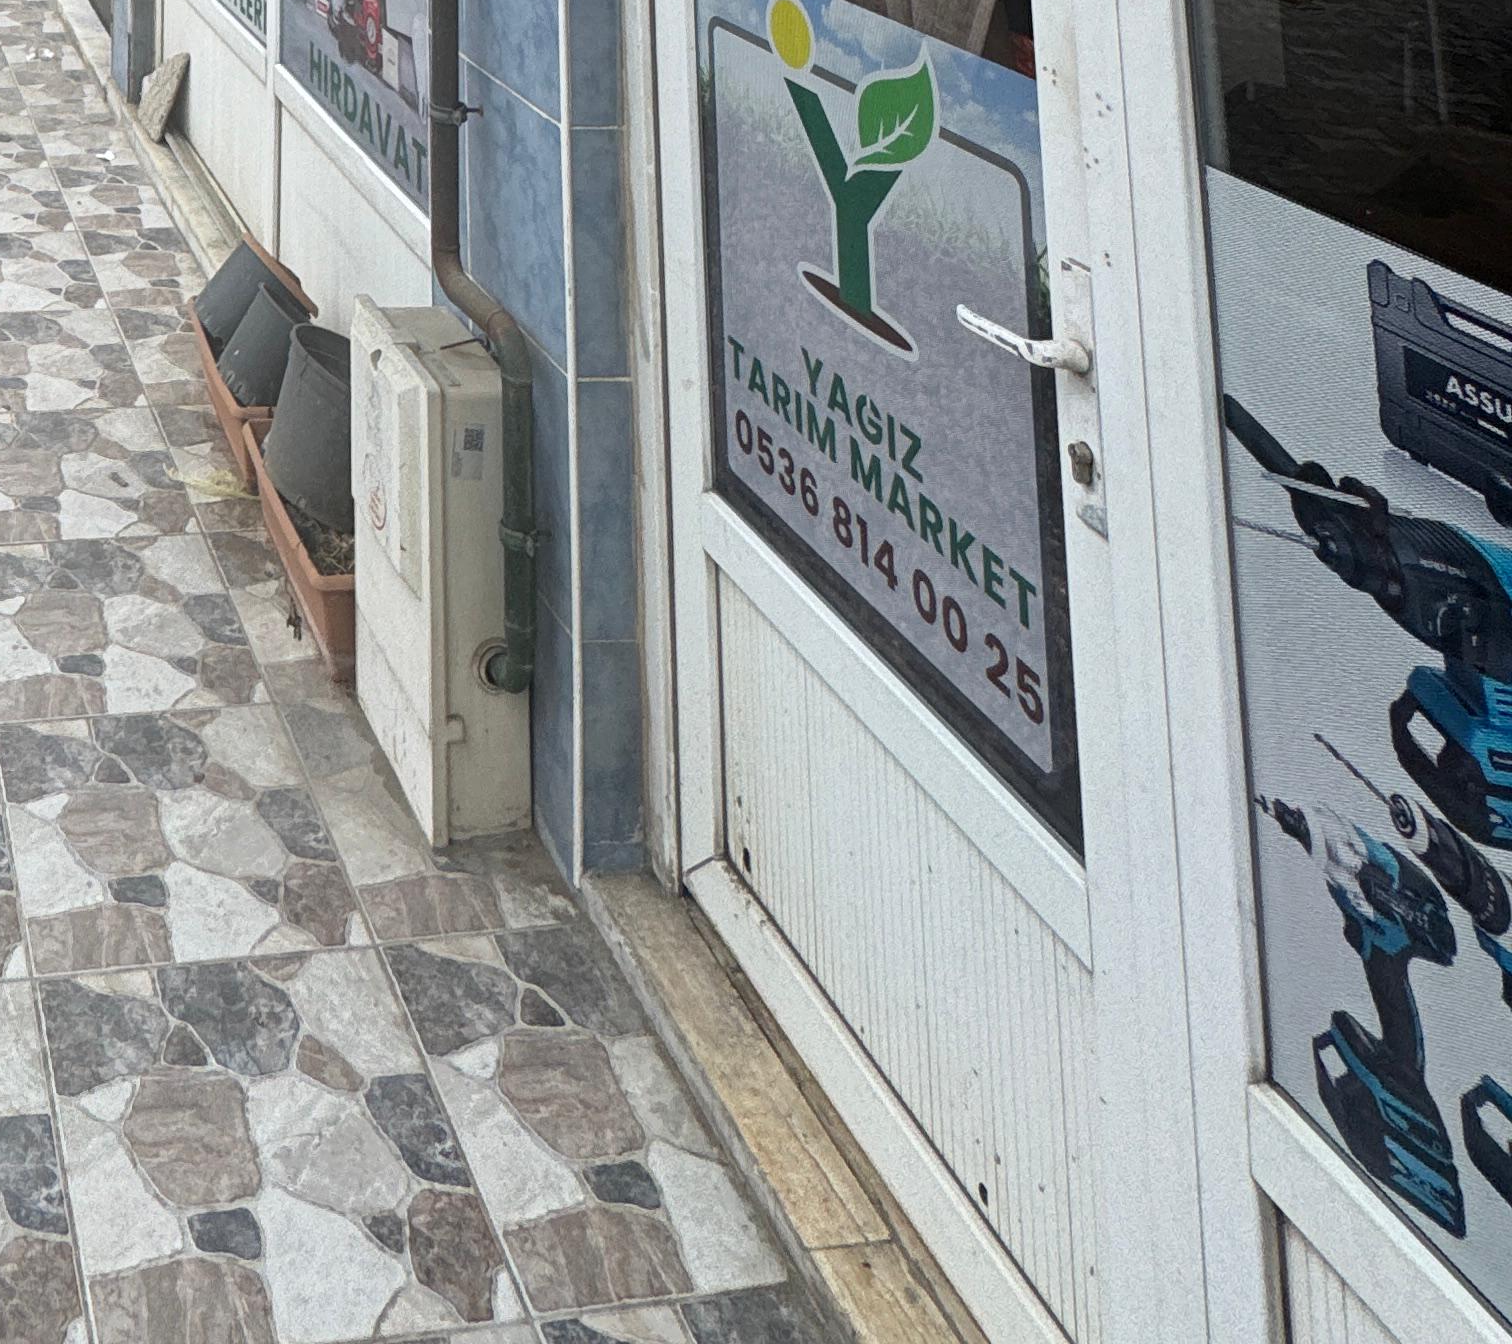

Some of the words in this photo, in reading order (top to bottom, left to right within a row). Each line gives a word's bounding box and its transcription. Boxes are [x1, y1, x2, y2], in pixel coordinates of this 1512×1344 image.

[309, 40, 428, 194] HIRDAVAT
[727, 334, 839, 464] TARIM
[734, 408, 820, 517] 0536
[832, 495, 899, 592] 814
[912, 568, 969, 653] 00
[984, 632, 1045, 726] 25
[848, 434, 1038, 630] MARKET
